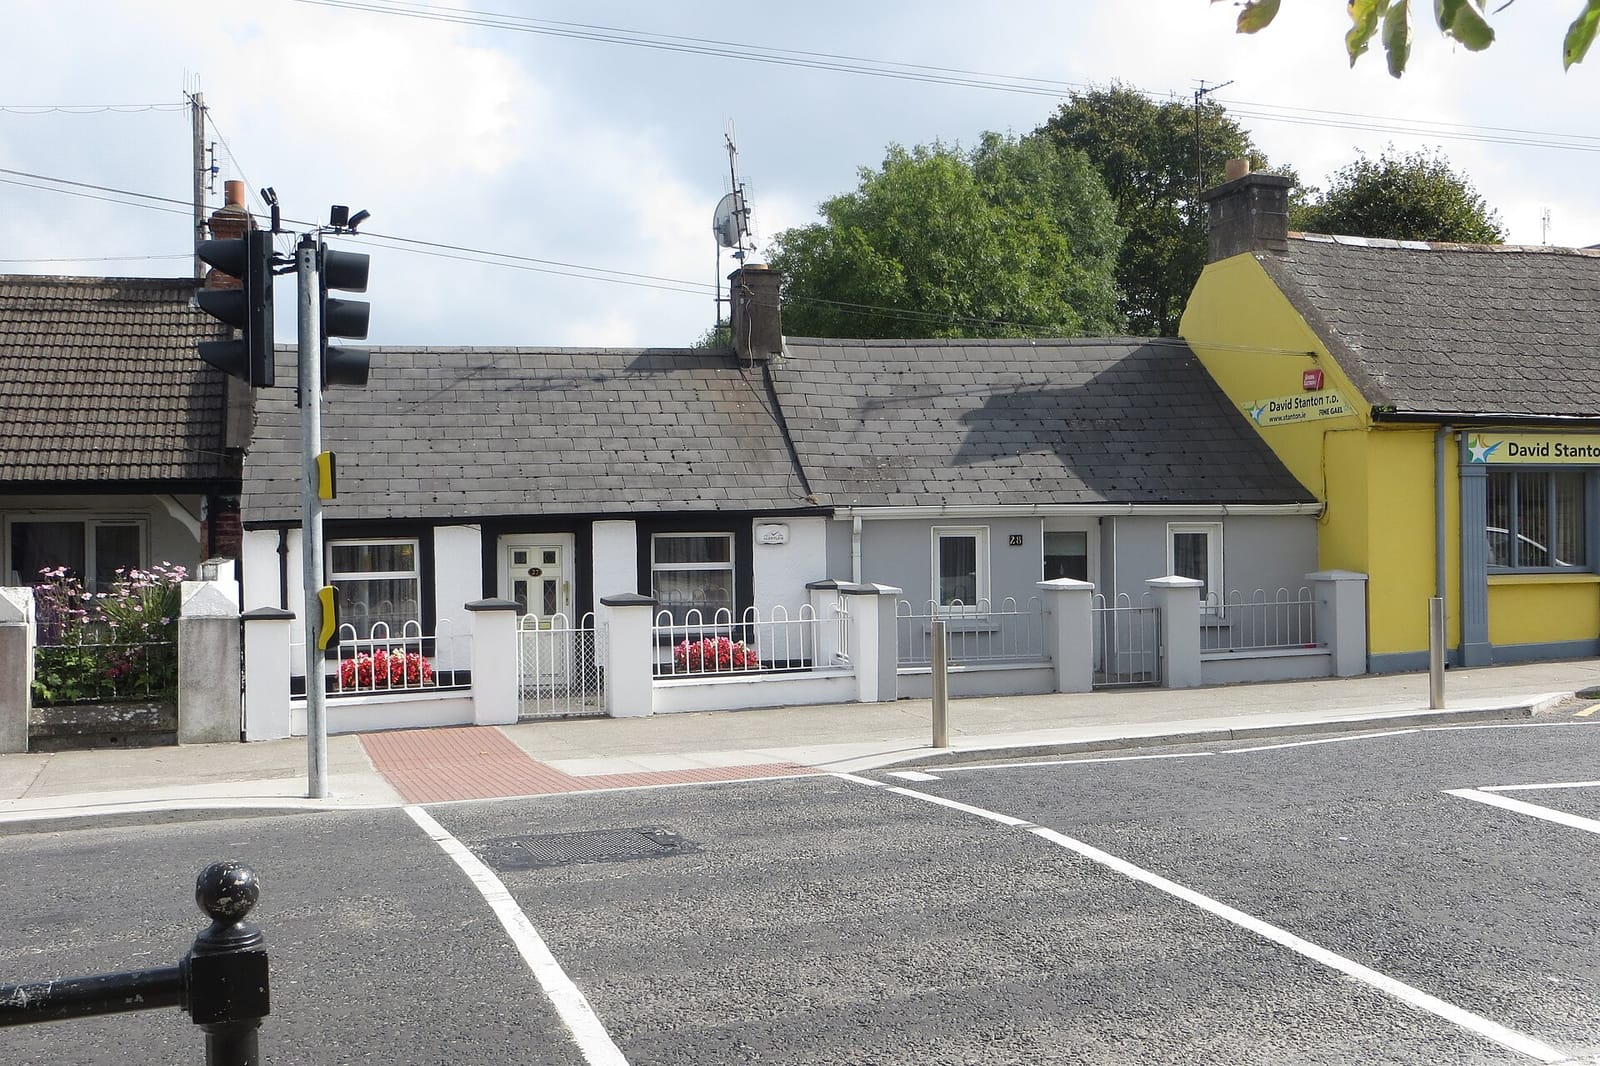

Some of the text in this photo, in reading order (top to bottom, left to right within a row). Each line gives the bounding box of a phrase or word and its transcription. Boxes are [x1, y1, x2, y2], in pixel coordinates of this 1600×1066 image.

[1269, 395, 1339, 412] David Stanton T.D.
[1330, 406, 1343, 415] GAEL
[1269, 412, 1306, 422] www.stanton.ie
[1508, 442, 1549, 457] David
[1010, 535, 1022, 545] 28
